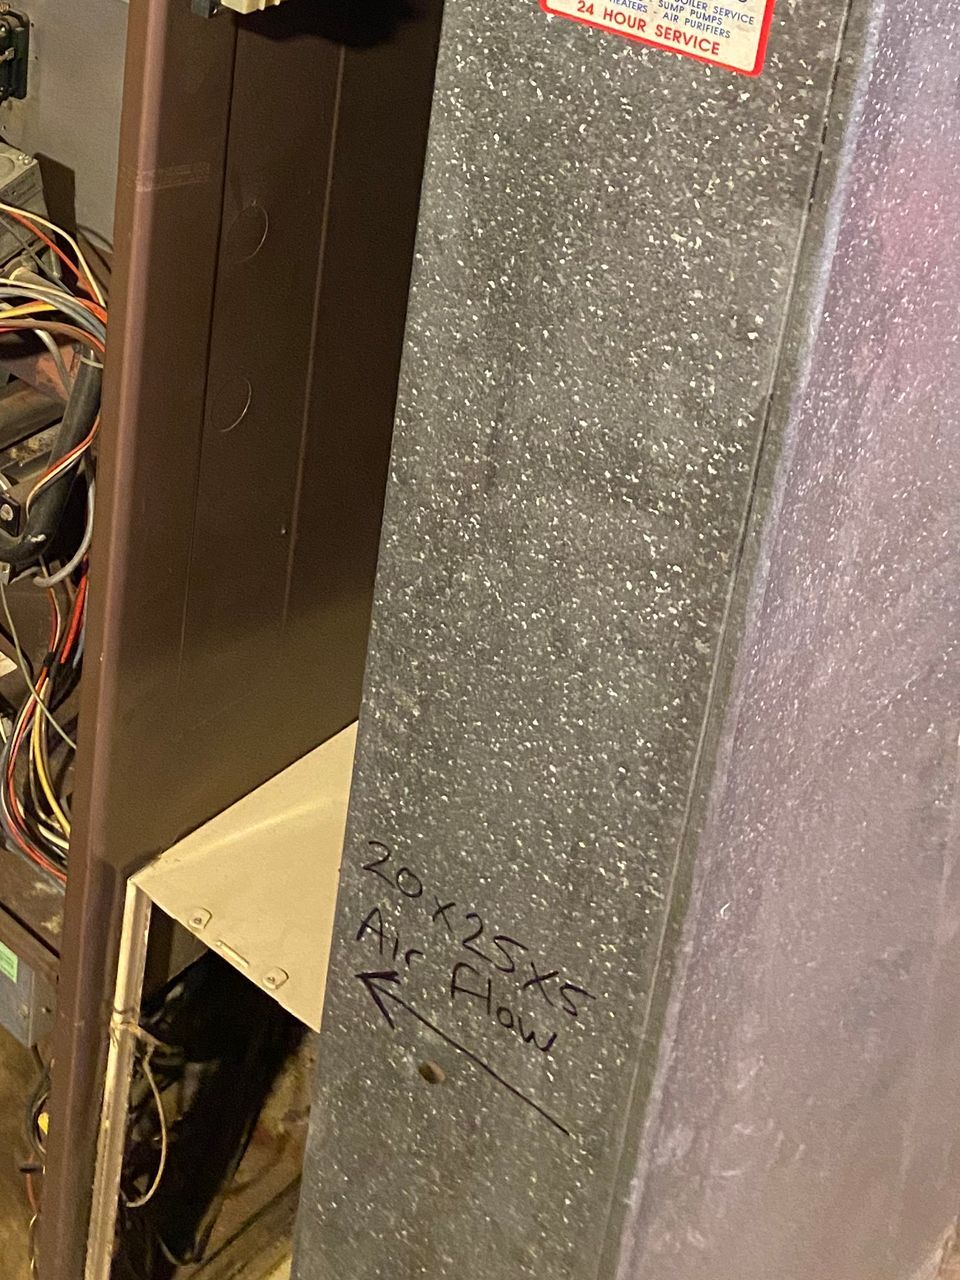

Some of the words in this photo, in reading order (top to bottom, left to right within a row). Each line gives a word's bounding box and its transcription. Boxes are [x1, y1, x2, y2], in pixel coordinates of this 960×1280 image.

[658, 0, 686, 15] SUMP
[690, 7, 723, 26] PUMPS
[662, 11, 679, 23] AIR
[684, 17, 731, 39] PURIFIERS
[713, 5, 754, 25] SERVICE
[576, 0, 595, 16] 24
[603, 8, 647, 33] HOUR
[654, 24, 721, 56] SERVICE
[356, 907, 424, 968] Air
[450, 962, 558, 1053] Flow
